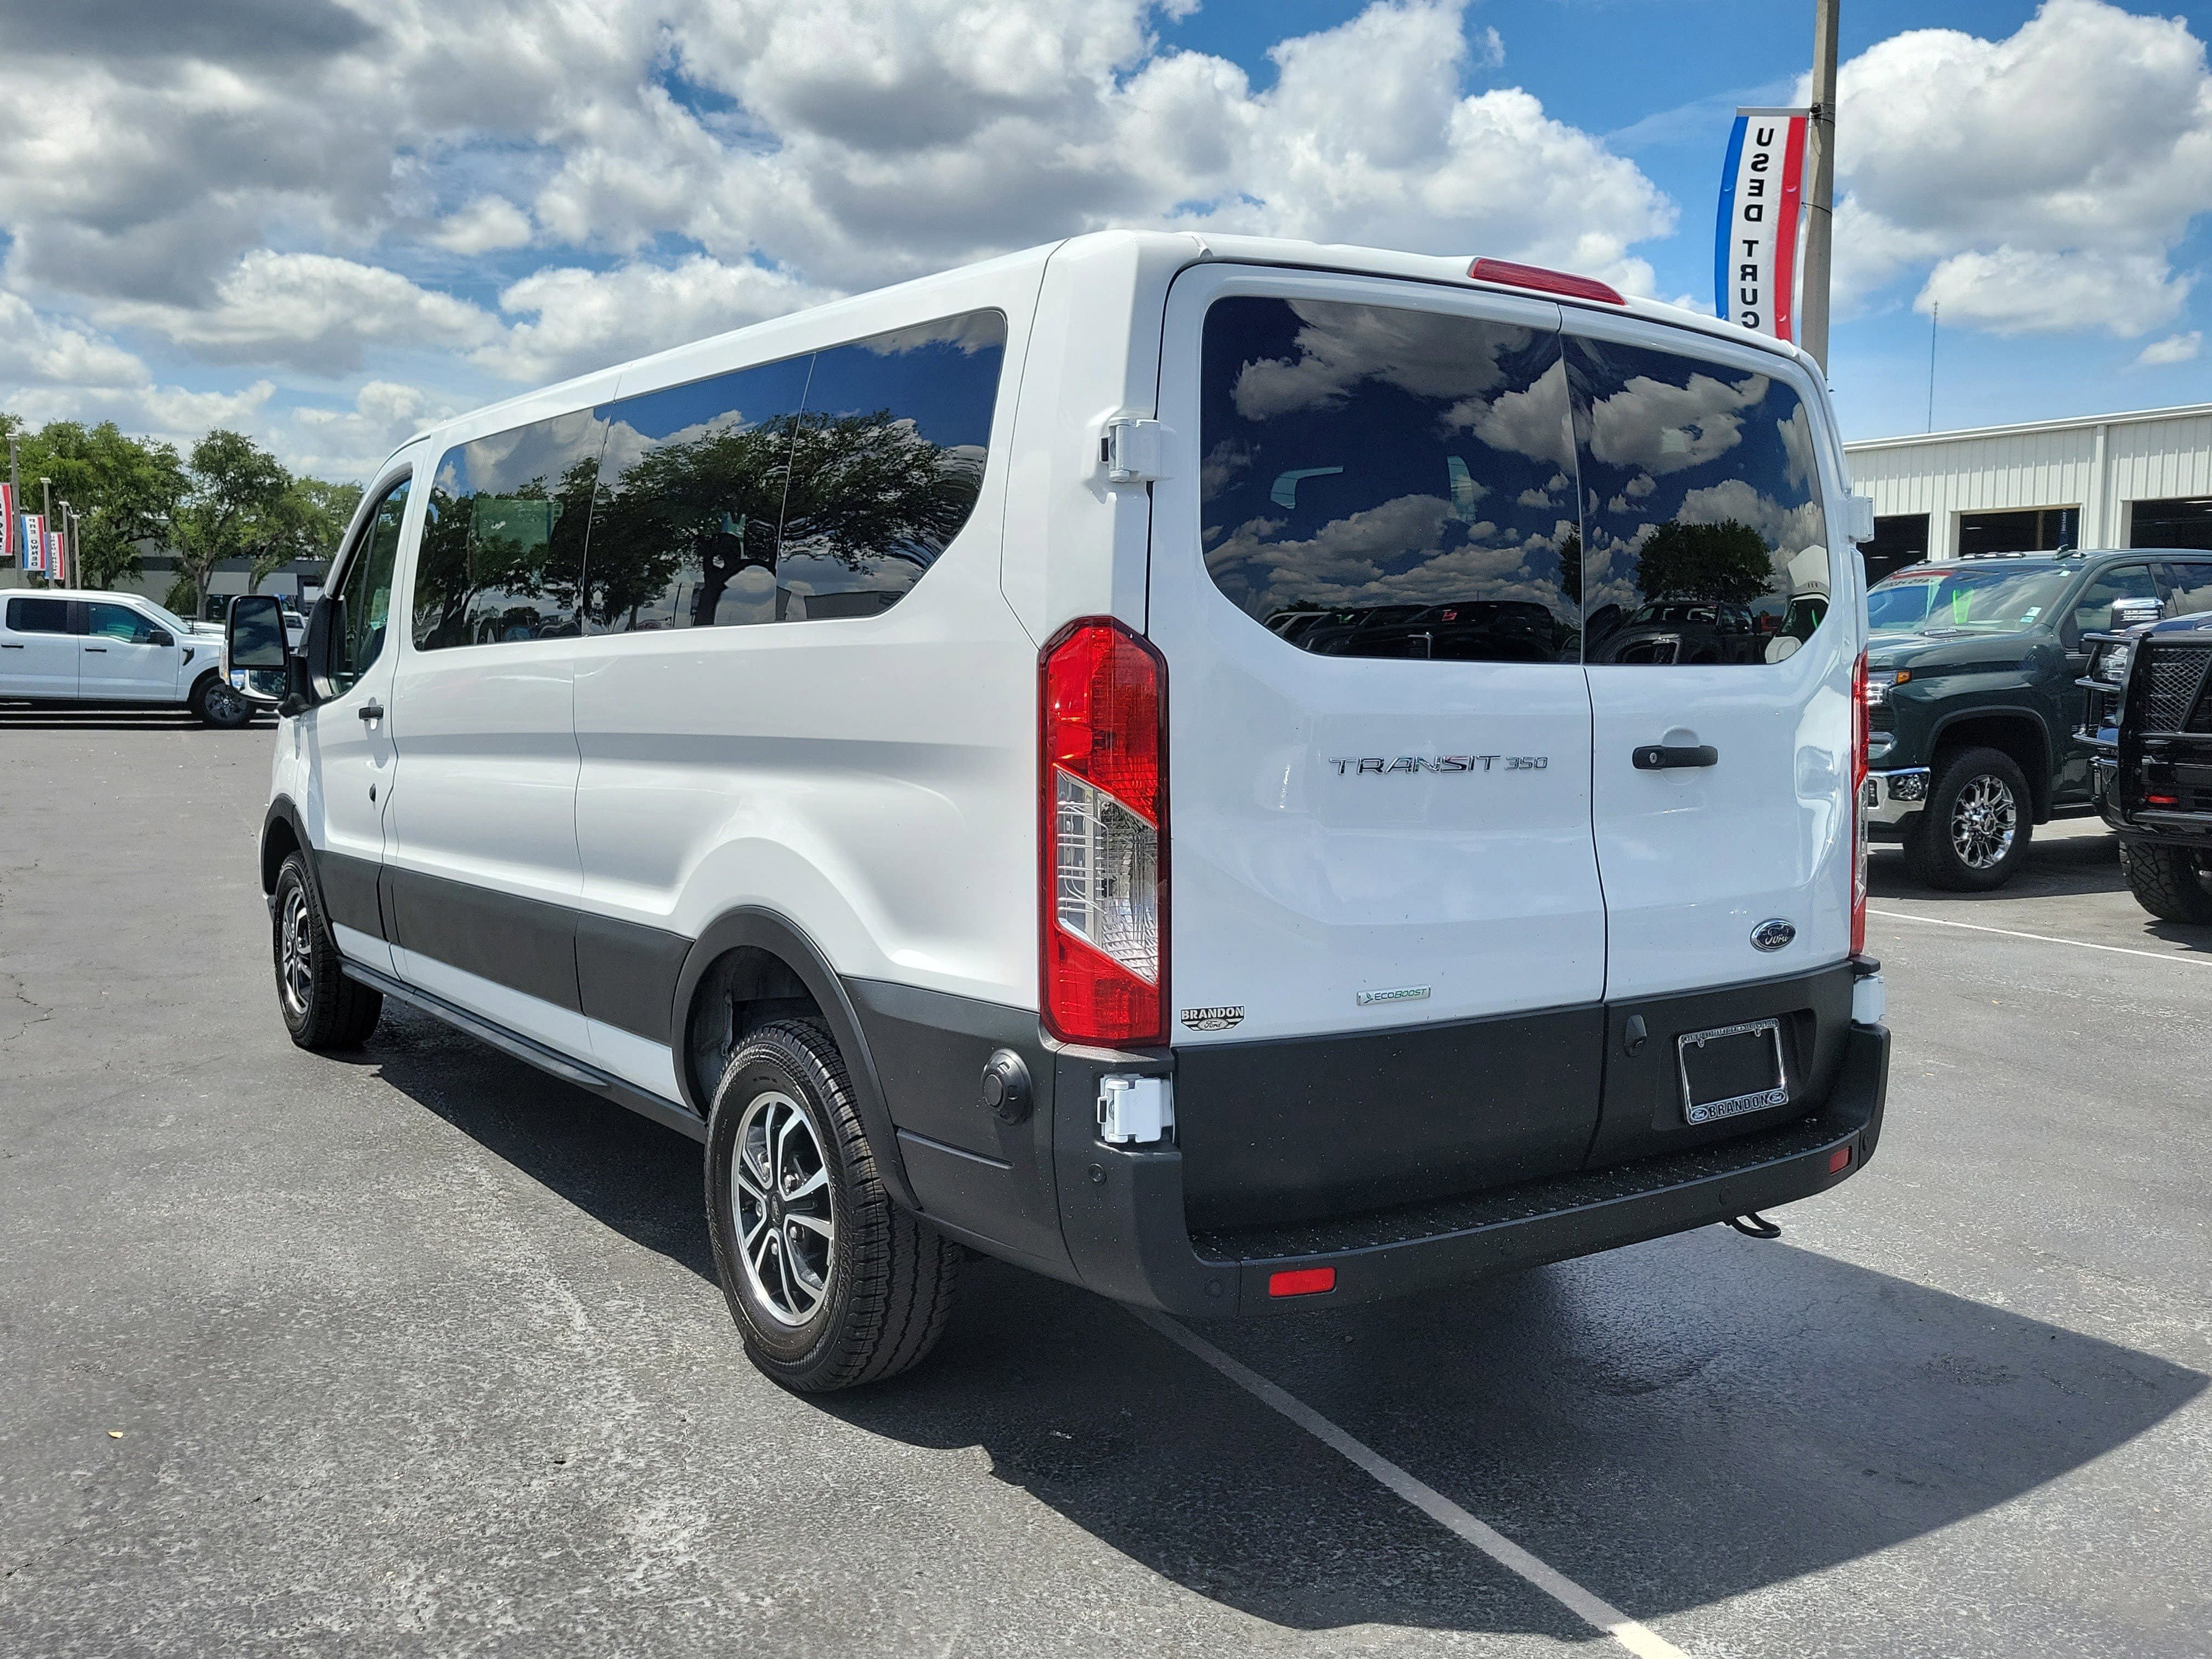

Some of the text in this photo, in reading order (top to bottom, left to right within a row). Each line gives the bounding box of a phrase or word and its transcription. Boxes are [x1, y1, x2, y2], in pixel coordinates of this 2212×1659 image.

[1329, 755, 1548, 775] TRANSIT 350
[1181, 1007, 1244, 1020] BRANDON
[1708, 1093, 1769, 1119] BRANDON
